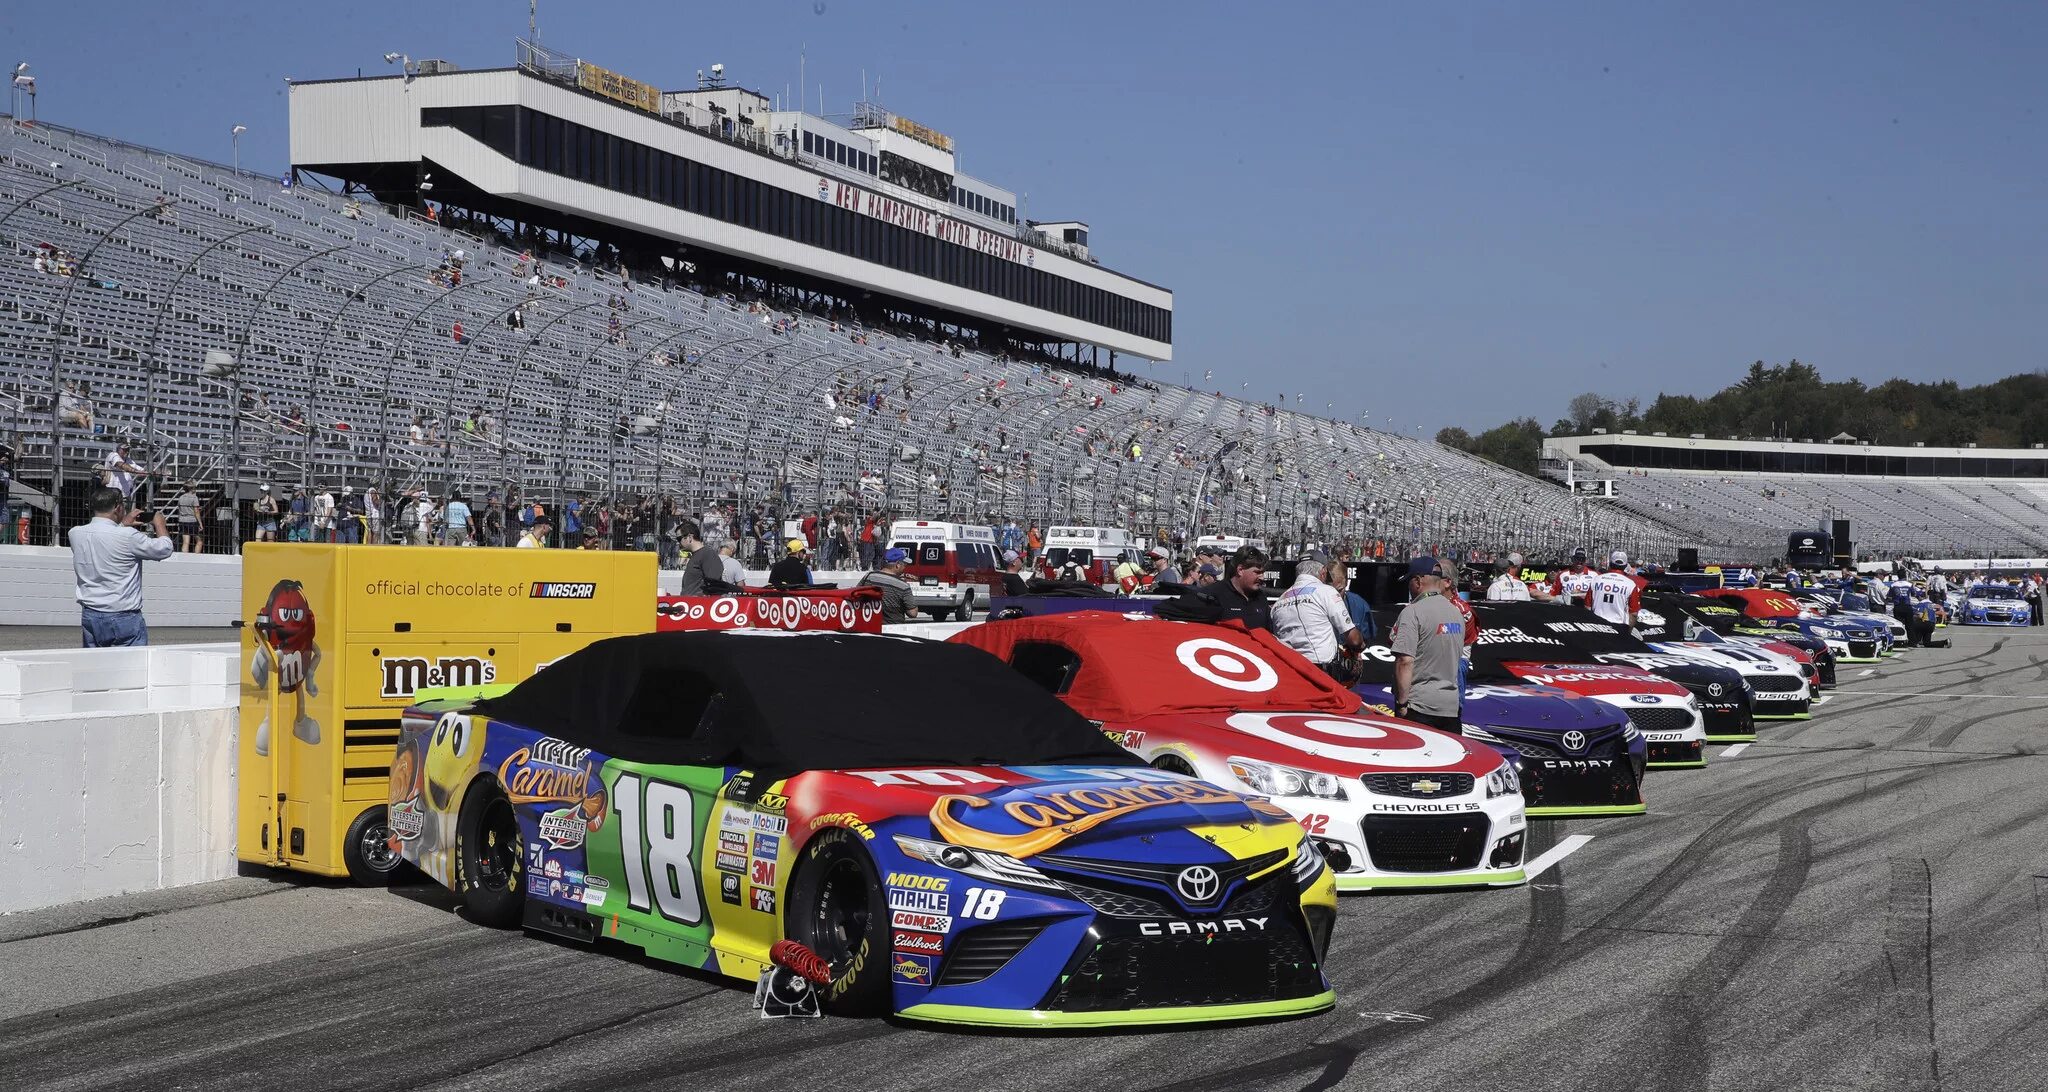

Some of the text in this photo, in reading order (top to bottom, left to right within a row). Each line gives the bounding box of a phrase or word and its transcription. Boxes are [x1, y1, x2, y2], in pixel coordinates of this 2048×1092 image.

[836, 182, 861, 213] NEW
[868, 193, 930, 235] HAMPSHIRE
[936, 219, 971, 248] MOTOR
[976, 231, 1023, 264] SPEEDWAY
[1520, 568, 1547, 582] 5-hour
[366, 581, 595, 598] official chocolate of NASCAR
[1594, 582, 1628, 595] Mobil
[1635, 694, 1658, 704] Ford
[1124, 731, 1144, 750] 3M
[1544, 760, 1613, 770] CAMRY
[499, 748, 592, 804] Caramel
[1372, 803, 1480, 812] CHEVROLET SS
[543, 817, 585, 832] INTERSTATE
[752, 813, 777, 830] Mobil
[810, 812, 876, 841] GOODYEAR
[929, 779, 1224, 860] Caramel
[1300, 815, 1330, 835] 42
[542, 829, 582, 842] BATTERIES
[720, 831, 745, 844] LINCOLN
[614, 772, 701, 926] 18
[724, 843, 746, 853] WELDERS
[811, 832, 849, 861] EAGLE
[716, 852, 747, 869] FLOWMASTER
[752, 859, 776, 887] 3M
[886, 872, 950, 892] MOOG
[755, 889, 775, 912] K&N
[890, 890, 947, 911] MAHLE
[960, 887, 1006, 920] 18
[894, 913, 936, 927] COMP
[1139, 917, 1269, 936] CAMRY
[894, 934, 942, 951] Edelbrock
[893, 964, 928, 975] SUNOCO
